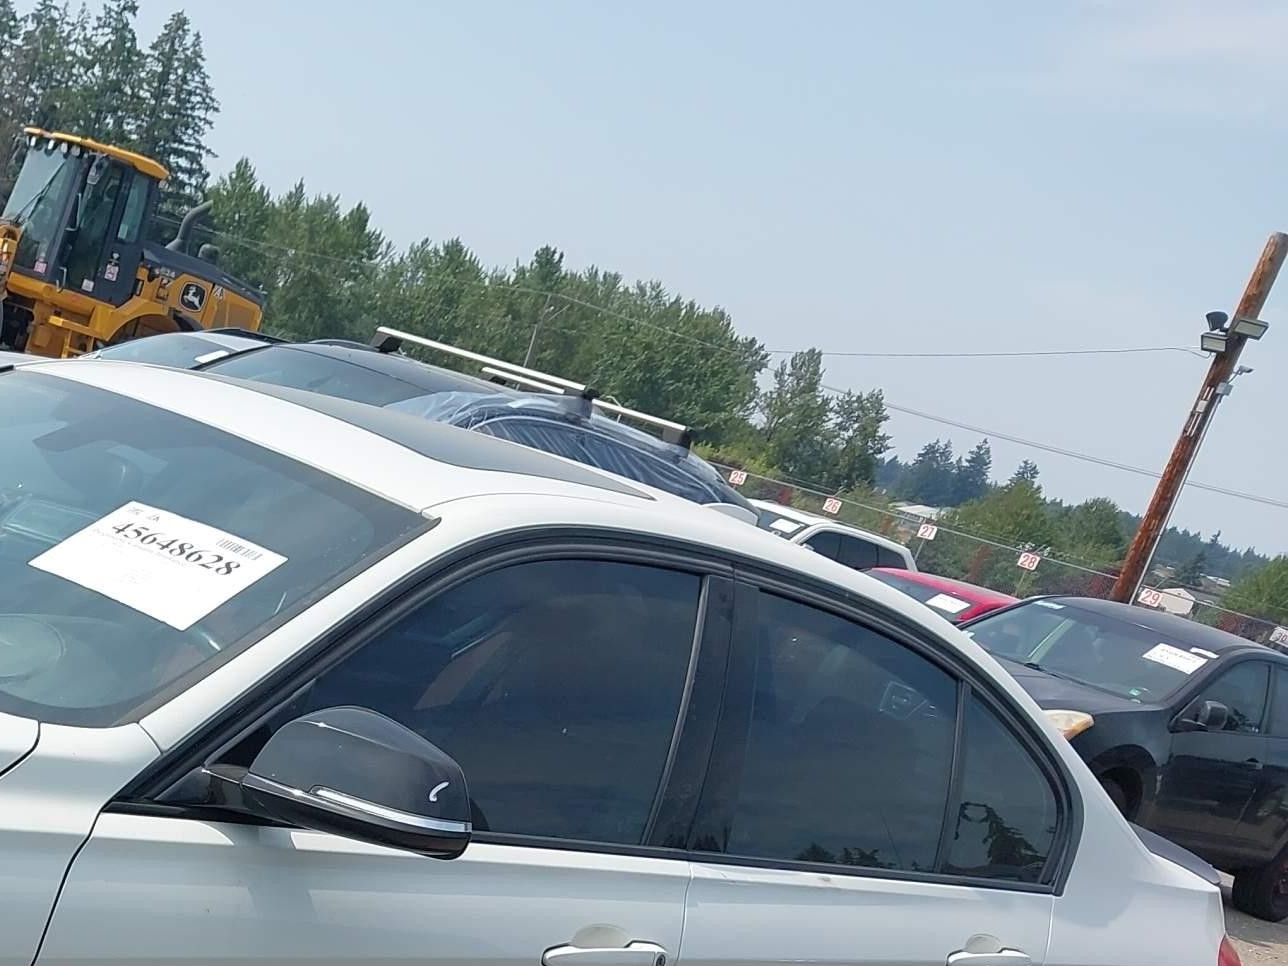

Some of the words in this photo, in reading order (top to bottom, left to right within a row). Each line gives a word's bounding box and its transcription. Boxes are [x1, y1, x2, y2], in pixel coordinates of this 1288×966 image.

[731, 471, 745, 484] 25
[824, 499, 840, 512] 26
[920, 526, 934, 539] 27
[112, 523, 241, 576] 45648628
[1020, 554, 1038, 569] 28
[1141, 590, 1161, 605] 29
